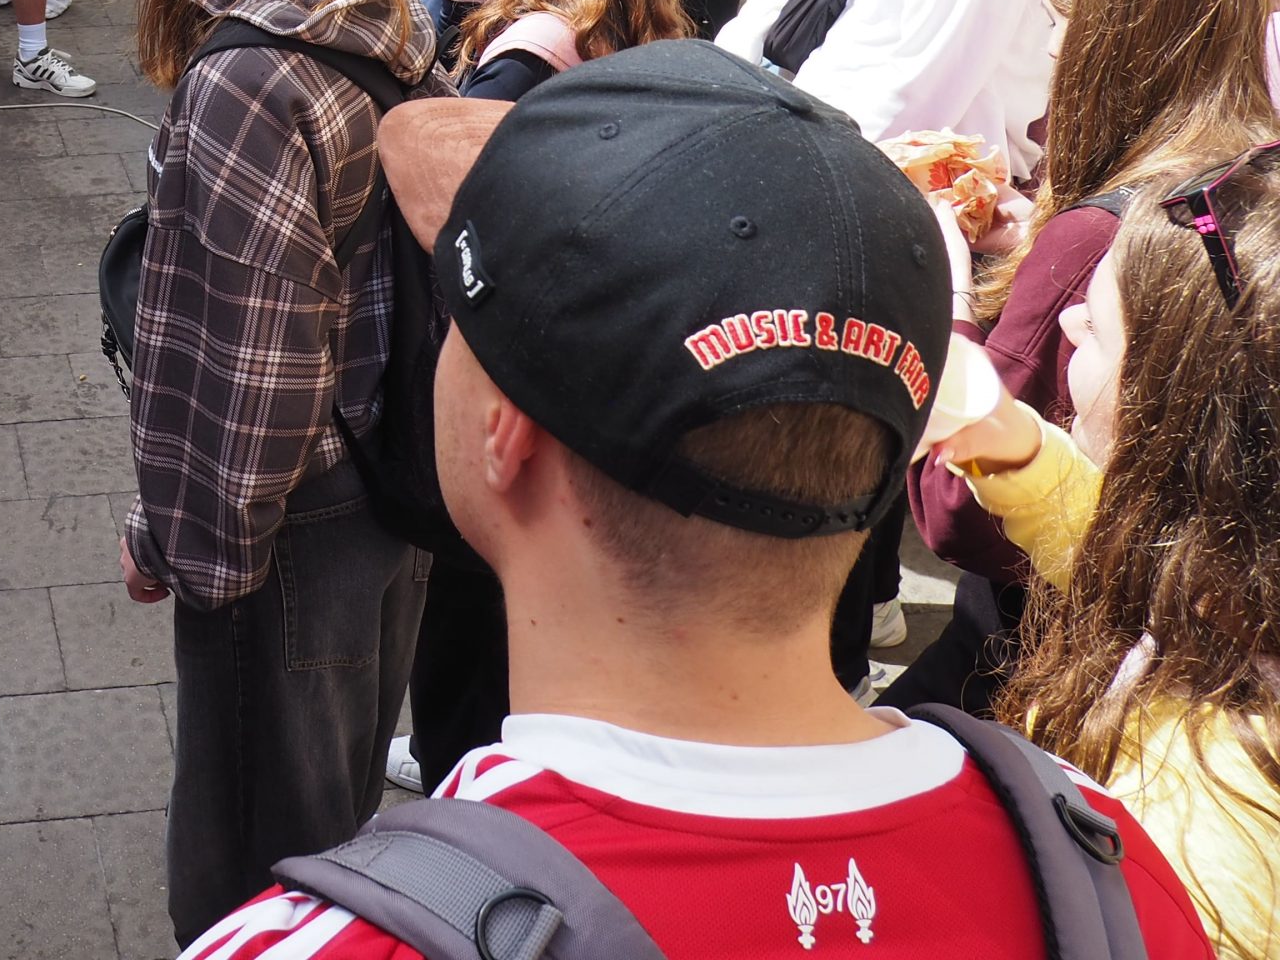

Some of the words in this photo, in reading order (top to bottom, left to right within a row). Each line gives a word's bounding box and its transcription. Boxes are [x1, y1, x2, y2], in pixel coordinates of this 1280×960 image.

[683, 309, 811, 371] MUSIC
[815, 311, 838, 351] &
[841, 317, 901, 367] ART
[815, 883, 847, 915] 97
